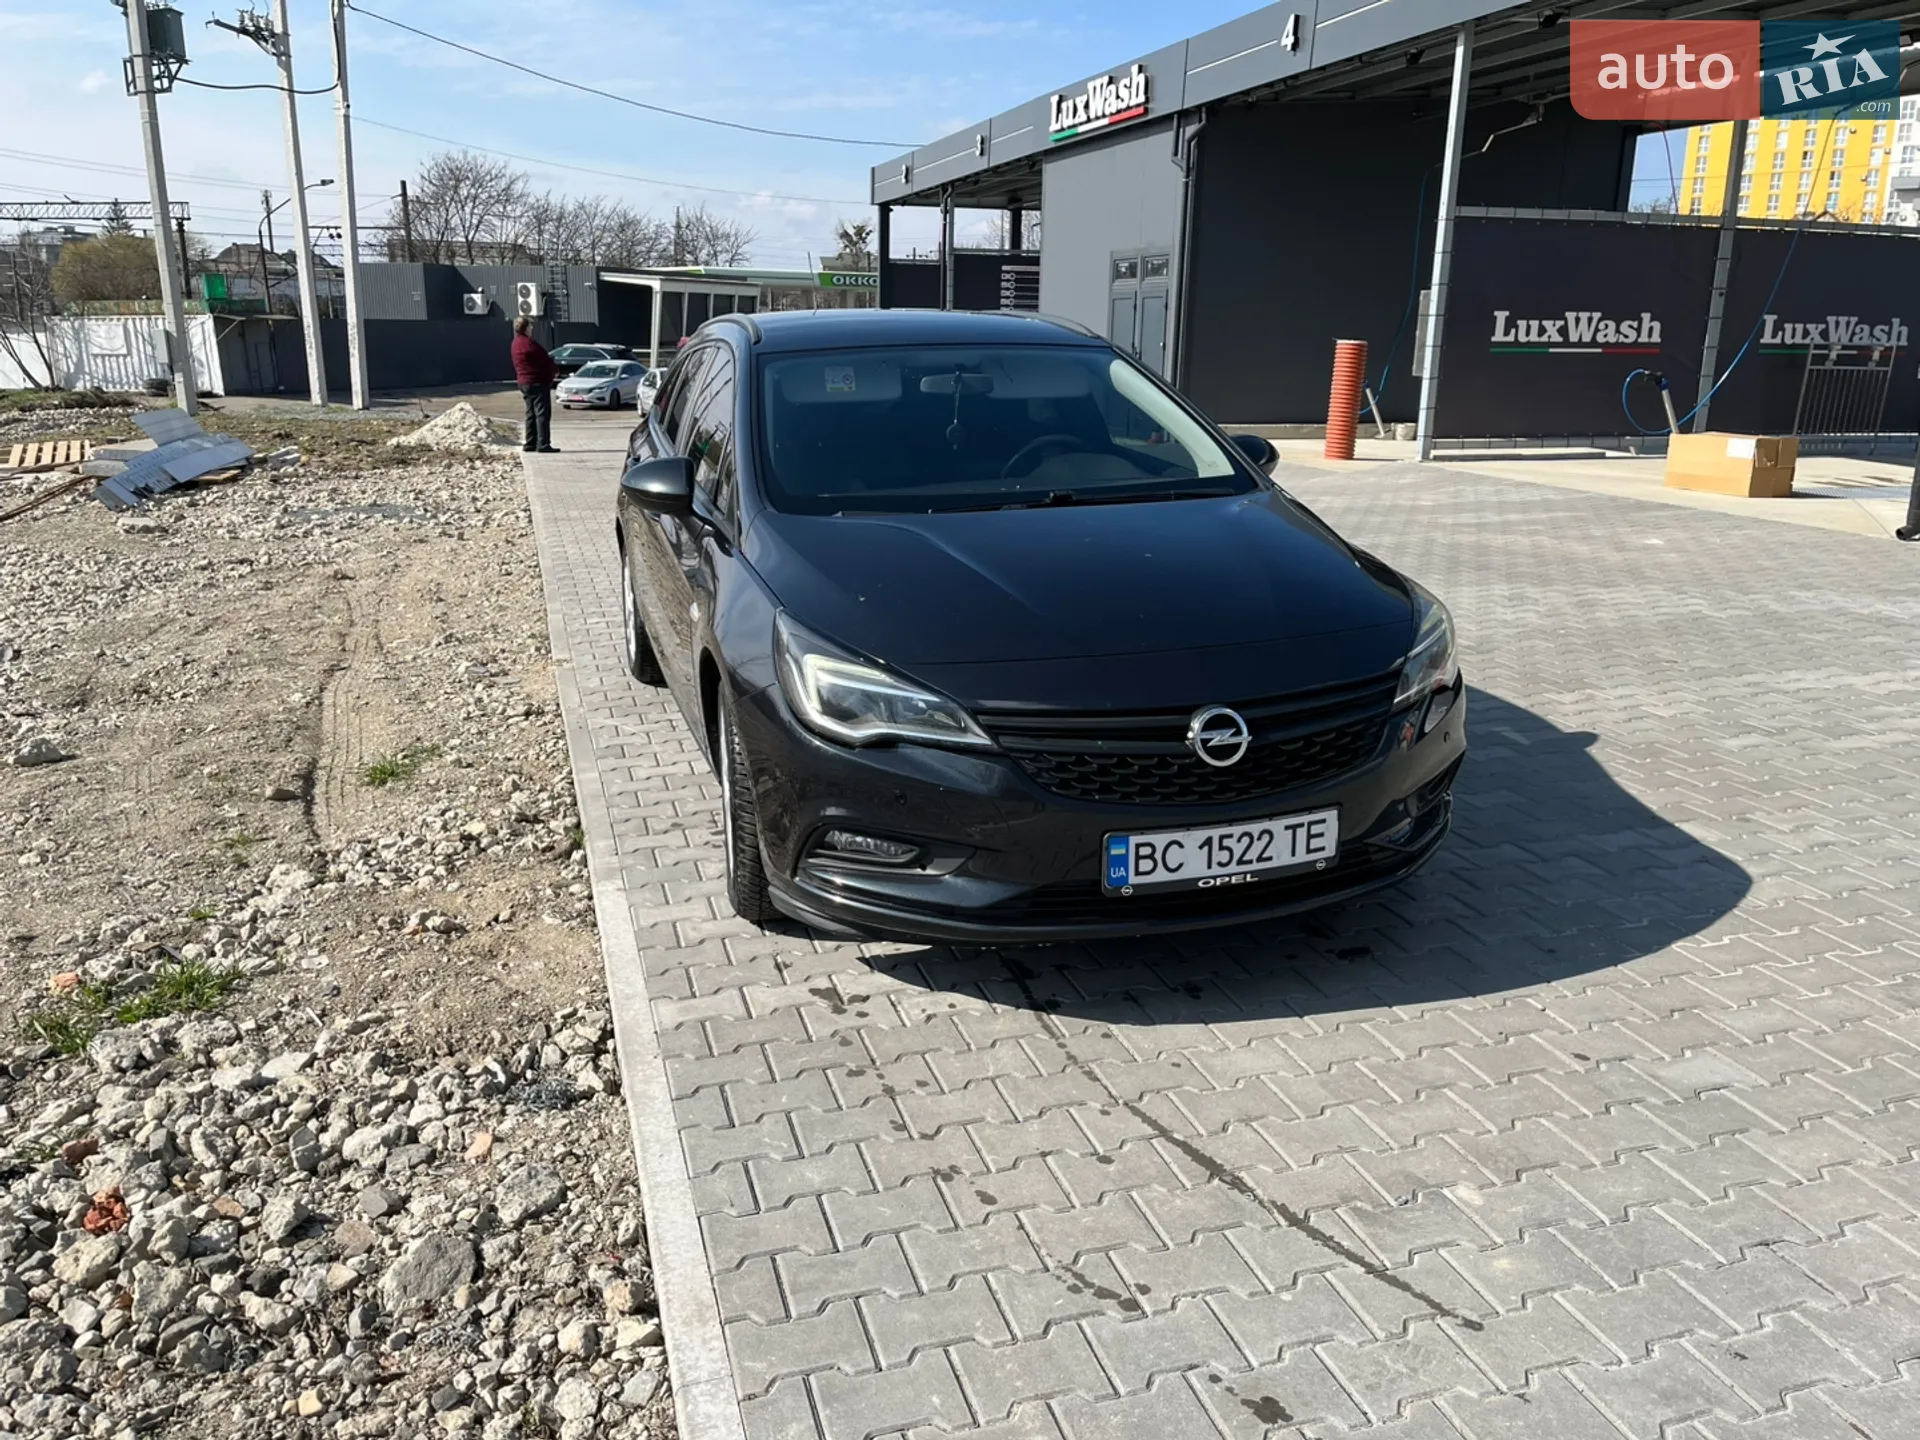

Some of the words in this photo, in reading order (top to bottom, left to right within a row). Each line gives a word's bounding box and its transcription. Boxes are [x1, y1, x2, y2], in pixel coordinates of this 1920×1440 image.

[1281, 13, 1296, 51] 4
[1049, 63, 1147, 132] LuxWash
[975, 133, 983, 156] 3
[832, 275, 879, 287] OKKO
[1491, 310, 1661, 343] LuxWash
[1759, 314, 1909, 346] LuxWash
[1134, 839, 1185, 877] BC
[1198, 829, 1275, 870] 1522
[1284, 818, 1327, 858] TE
[1110, 866, 1126, 878] UA
[1198, 873, 1259, 887] OPEL
